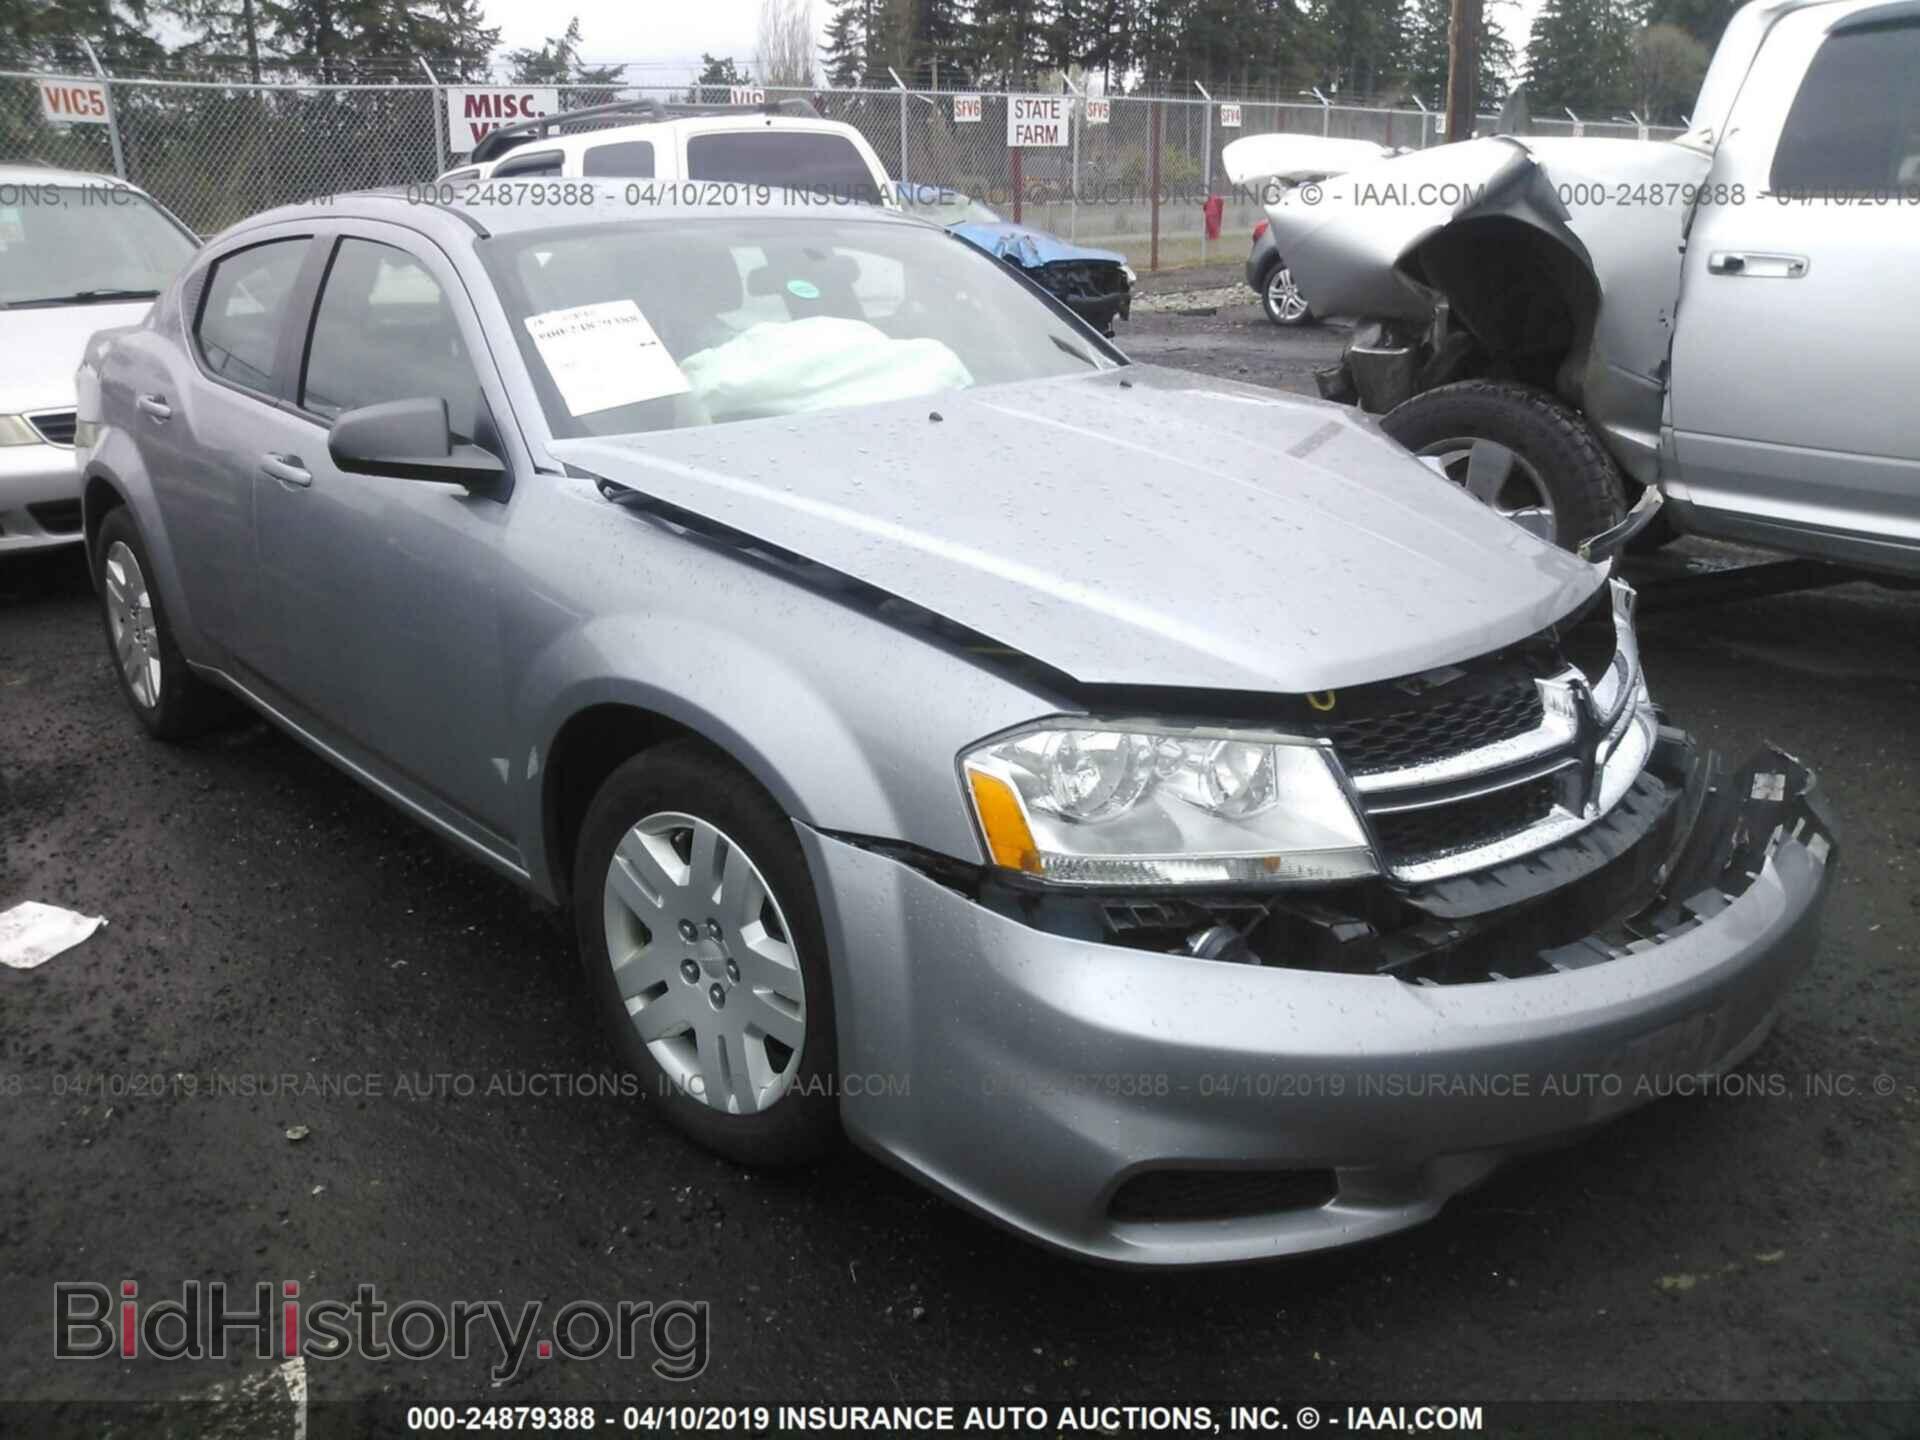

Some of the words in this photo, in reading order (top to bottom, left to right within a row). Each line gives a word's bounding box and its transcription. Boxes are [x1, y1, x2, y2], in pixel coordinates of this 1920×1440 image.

[44, 86, 105, 116] VIC5
[464, 94, 546, 118] MISC.
[1015, 100, 1060, 119] STATE
[1016, 124, 1058, 144] FARM
